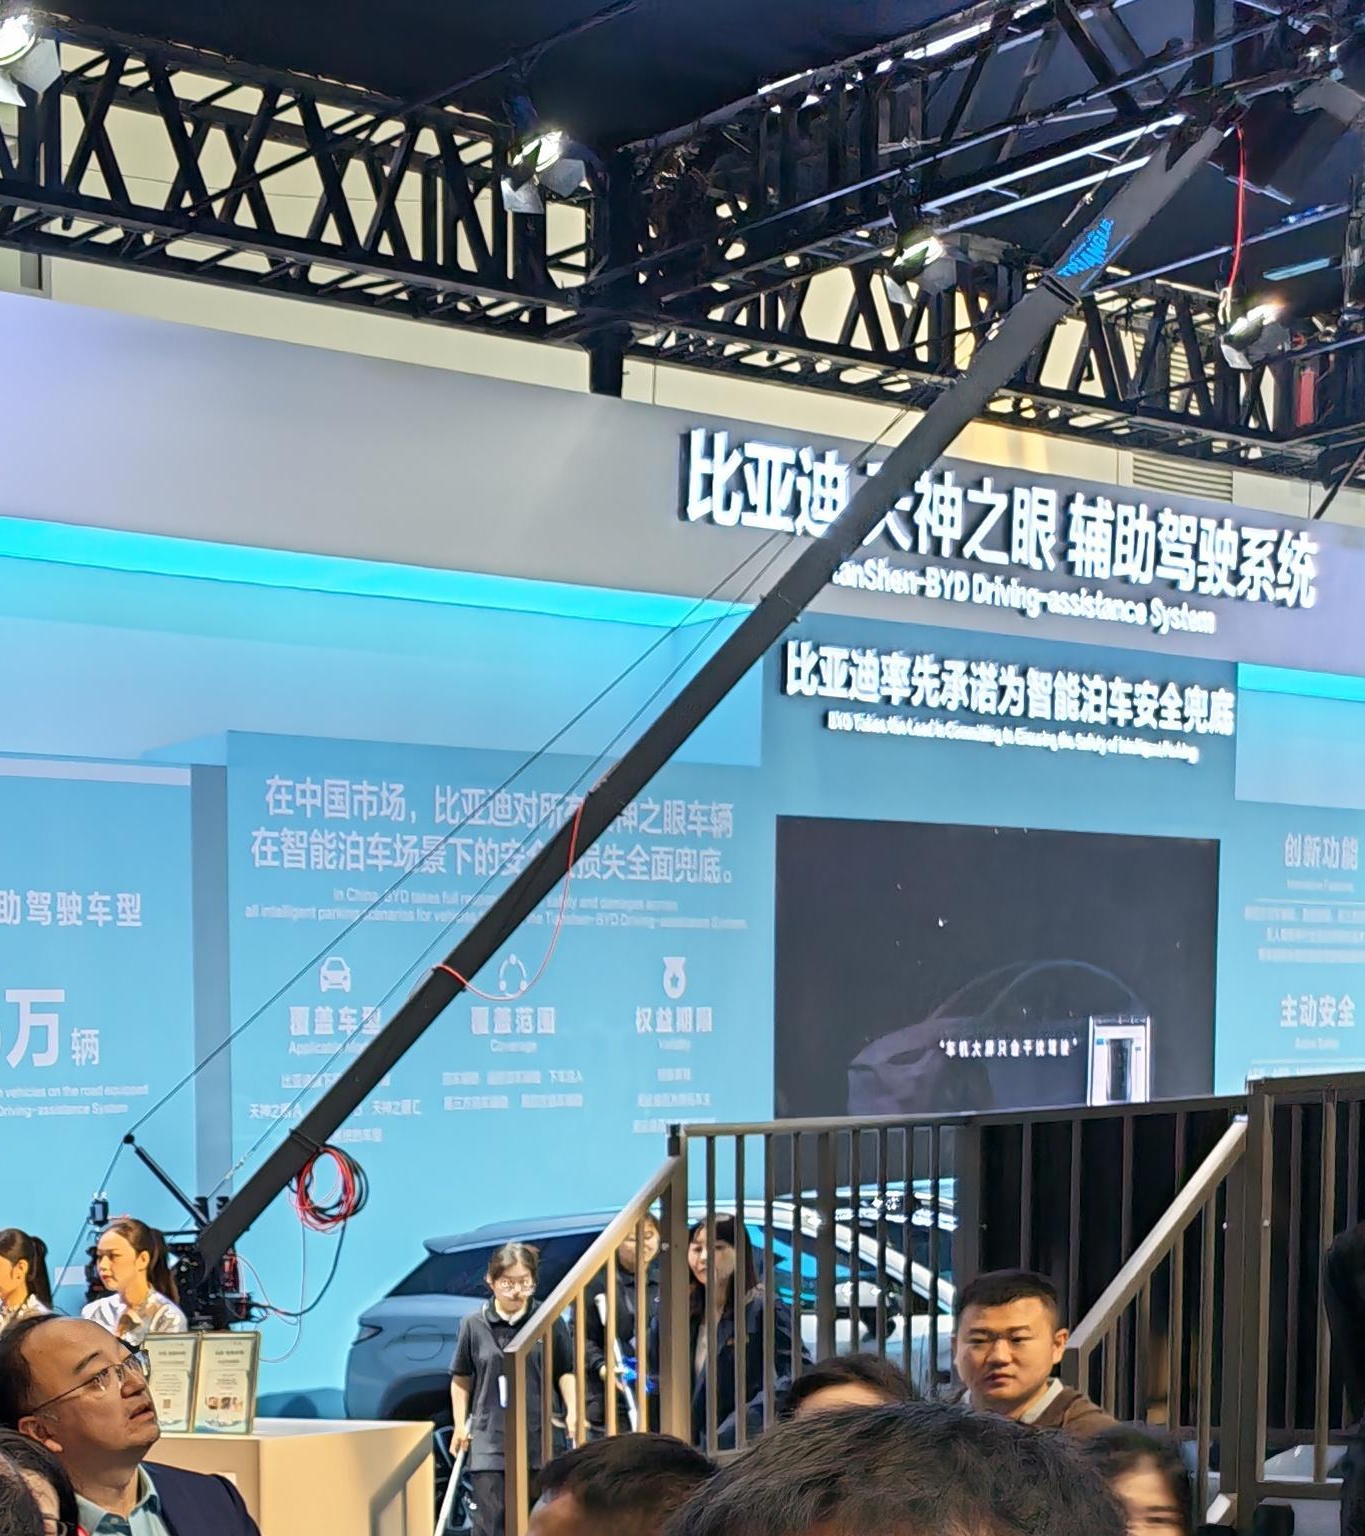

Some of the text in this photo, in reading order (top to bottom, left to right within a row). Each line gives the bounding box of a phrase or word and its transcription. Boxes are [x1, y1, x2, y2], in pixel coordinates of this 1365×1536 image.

[683, 428, 851, 538] 比亚迪
[1067, 494, 1319, 609] 辅助驾驶系统
[832, 556, 971, 602] anShen-BYD
[265, 774, 734, 839] 在中国市场，比亚迪对所神之眼车辆
[251, 826, 733, 884] 在智能泊车场景下的安损失全面兜底。
